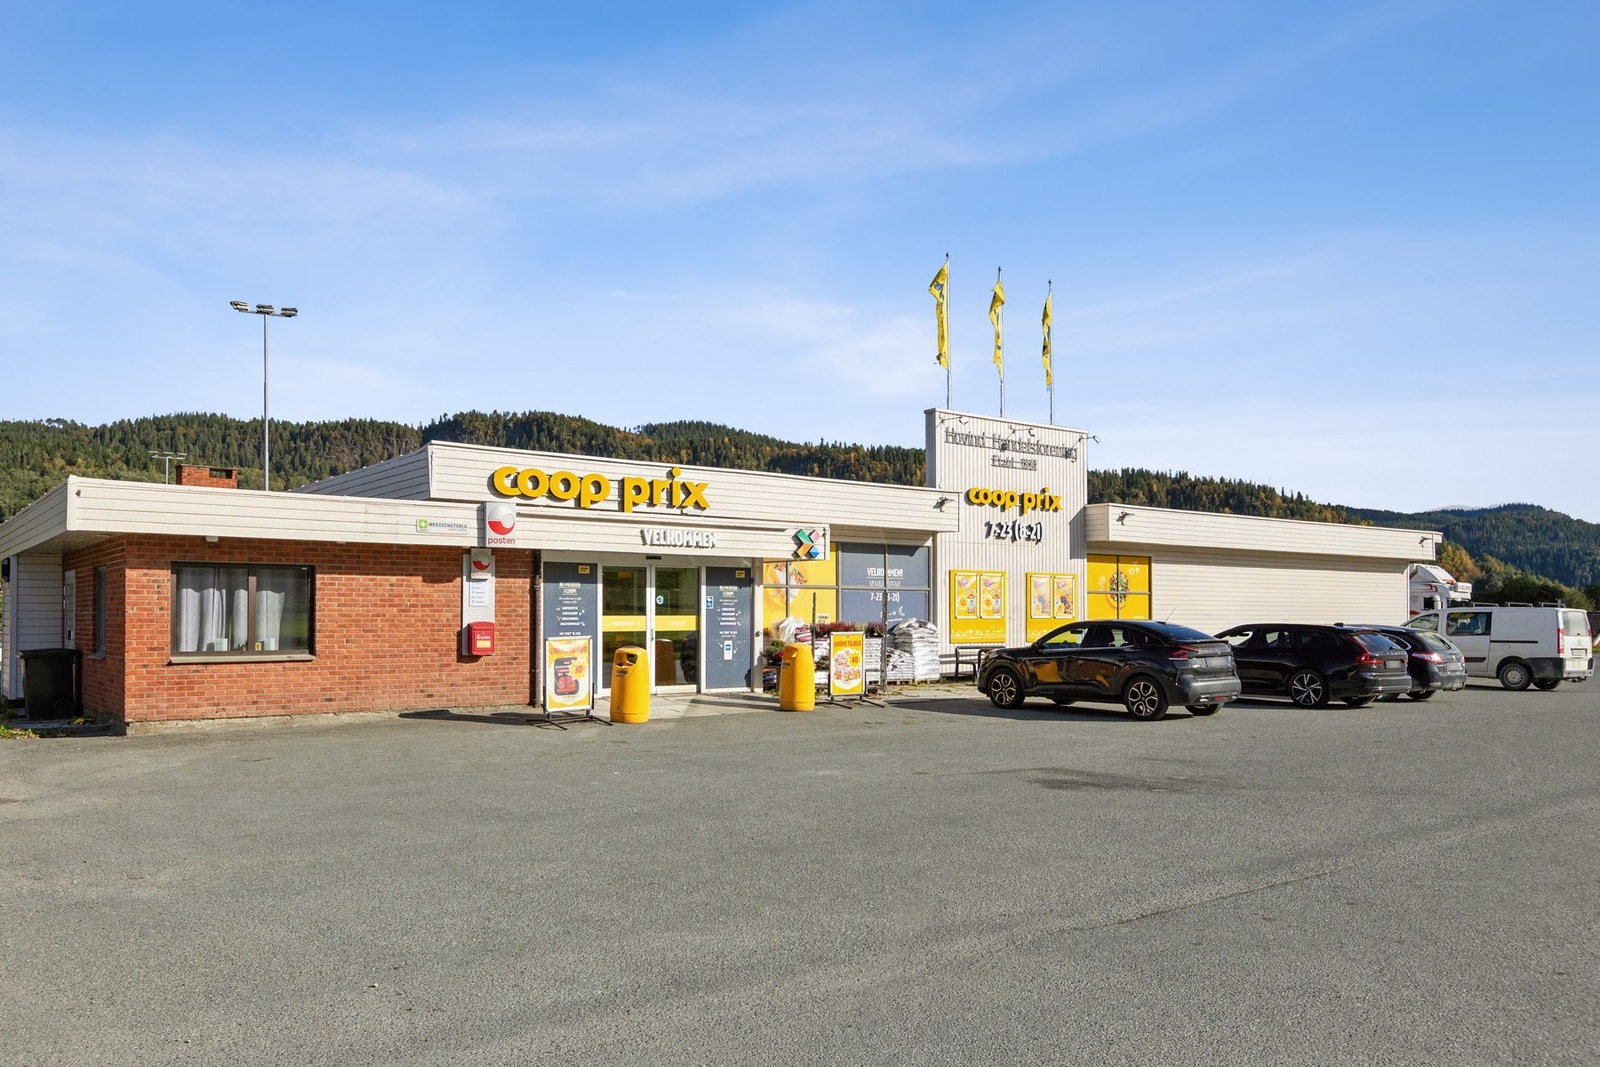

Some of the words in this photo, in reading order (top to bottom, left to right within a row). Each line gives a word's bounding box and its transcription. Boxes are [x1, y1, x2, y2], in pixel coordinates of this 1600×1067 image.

[493, 465, 611, 509] coop
[623, 466, 712, 514] prix
[967, 486, 1019, 511] coop
[1022, 486, 1063, 515] prix
[487, 536, 516, 546] posten
[641, 528, 718, 549] VELKOMMEN
